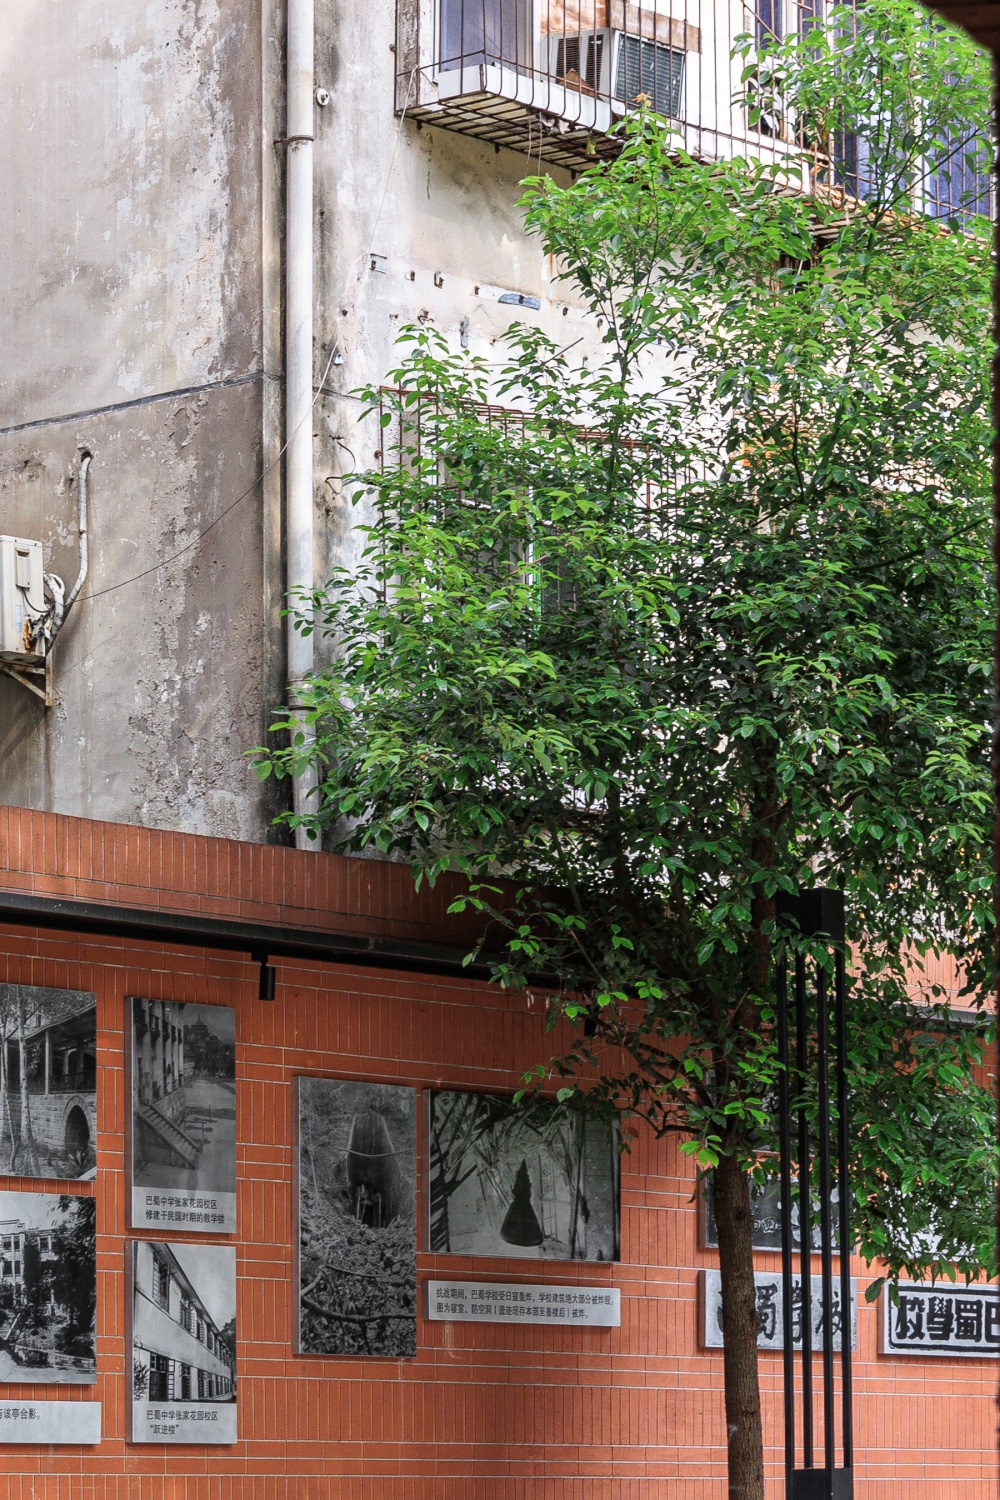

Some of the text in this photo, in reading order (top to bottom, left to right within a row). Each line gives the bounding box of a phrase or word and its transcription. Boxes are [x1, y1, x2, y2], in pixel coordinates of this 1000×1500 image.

[145, 1195, 218, 1210] 巴蜀中学张家花园校区
[145, 1210, 225, 1225] 修建于民国时期的教学楼
[146, 1409, 218, 1421] 巴蜀中学张家花园校区
